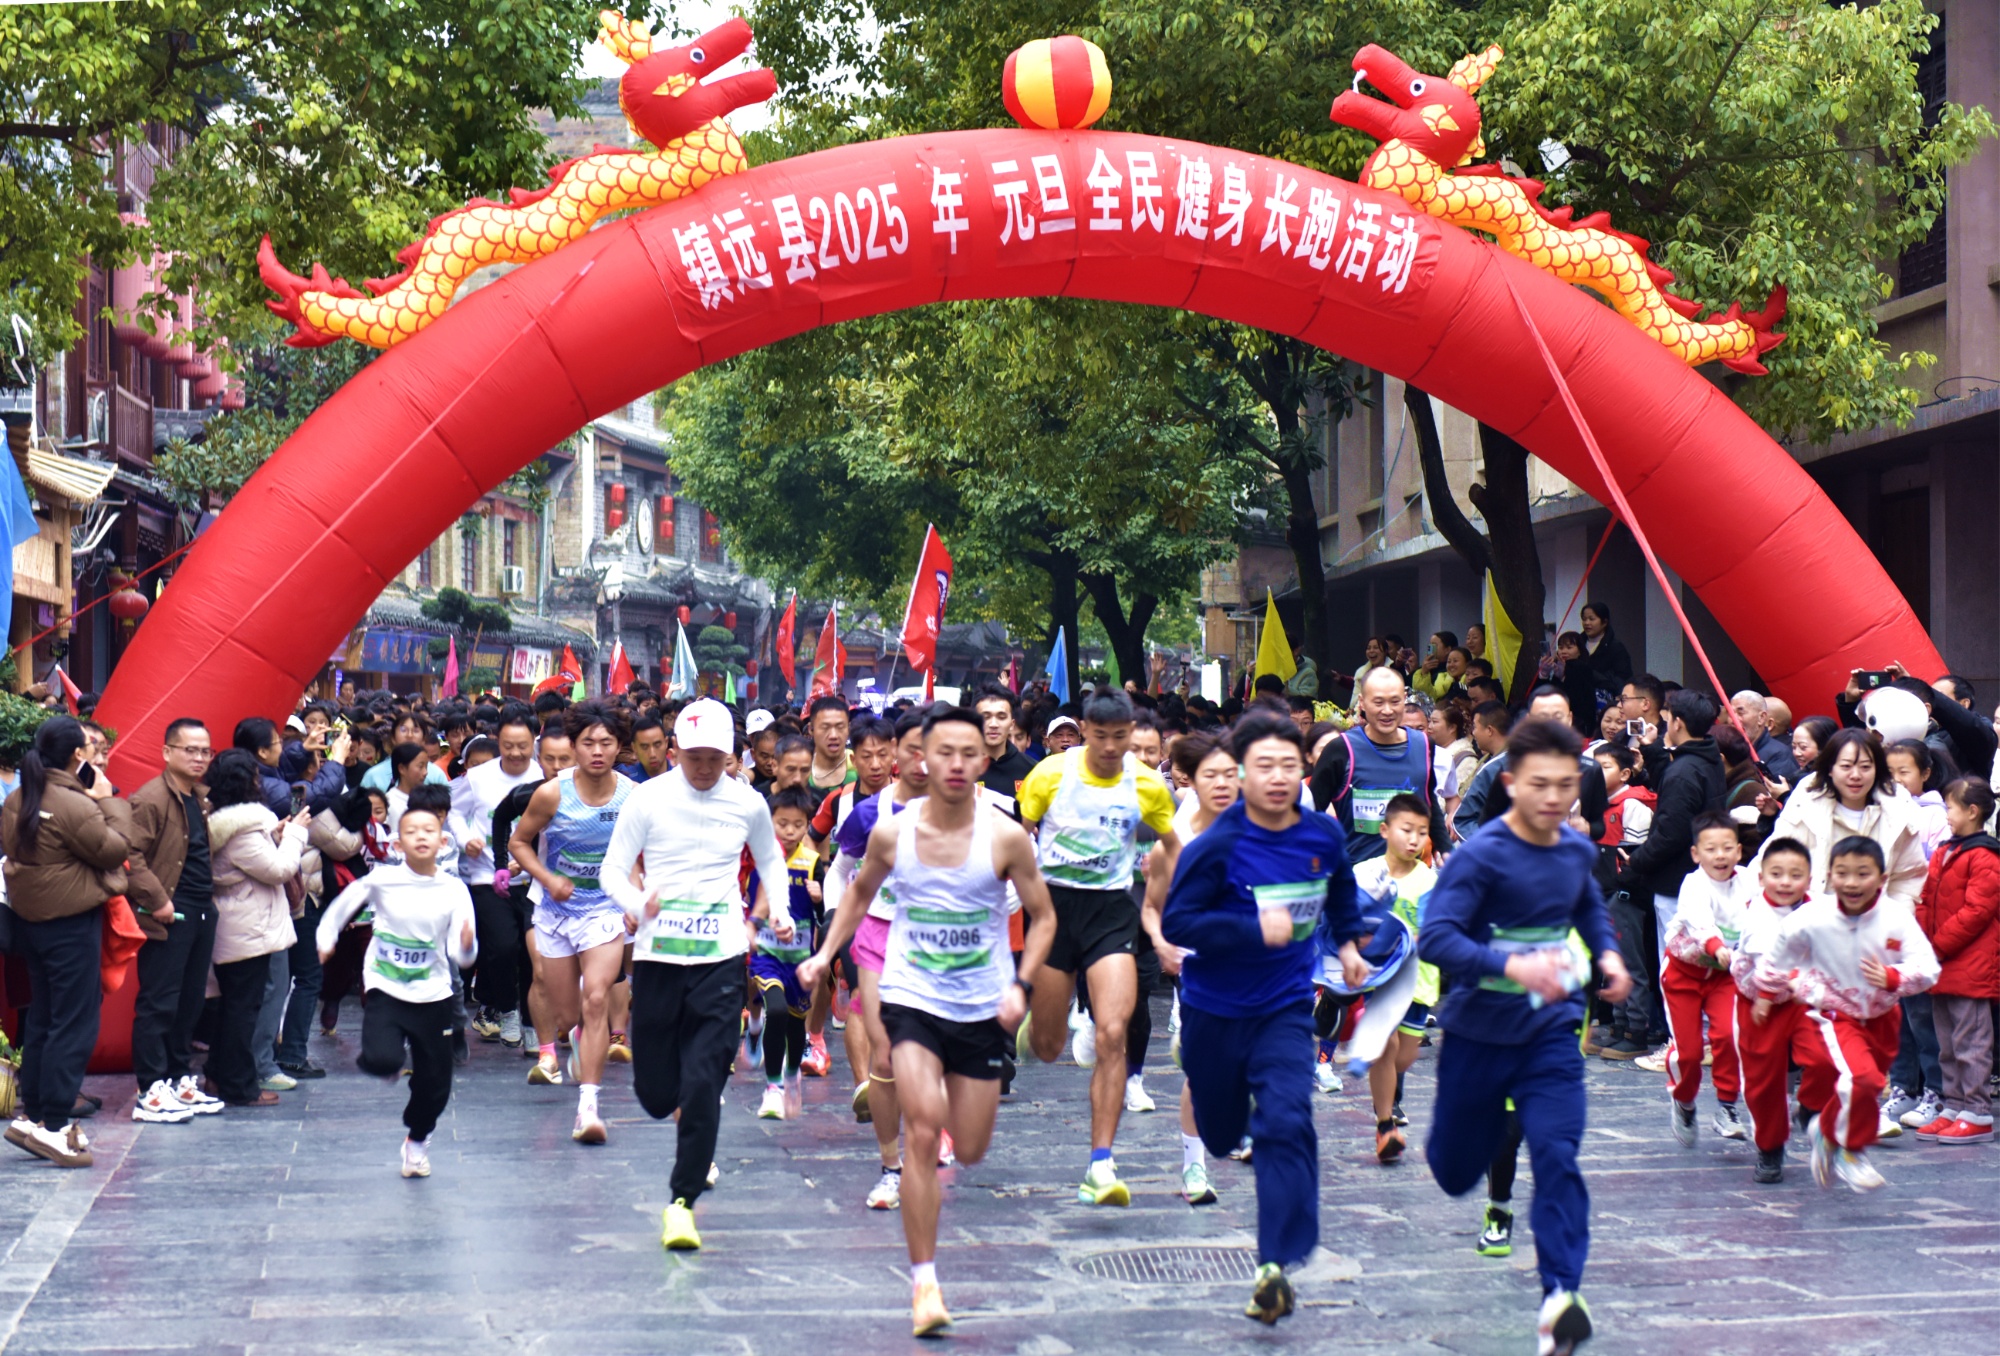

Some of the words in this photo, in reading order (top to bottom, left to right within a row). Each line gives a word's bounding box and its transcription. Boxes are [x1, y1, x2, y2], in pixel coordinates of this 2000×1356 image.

[580, 866, 600, 877] 207
[684, 917, 720, 935] 2123
[938, 928, 981, 948] 2096
[394, 948, 427, 964] 5101
